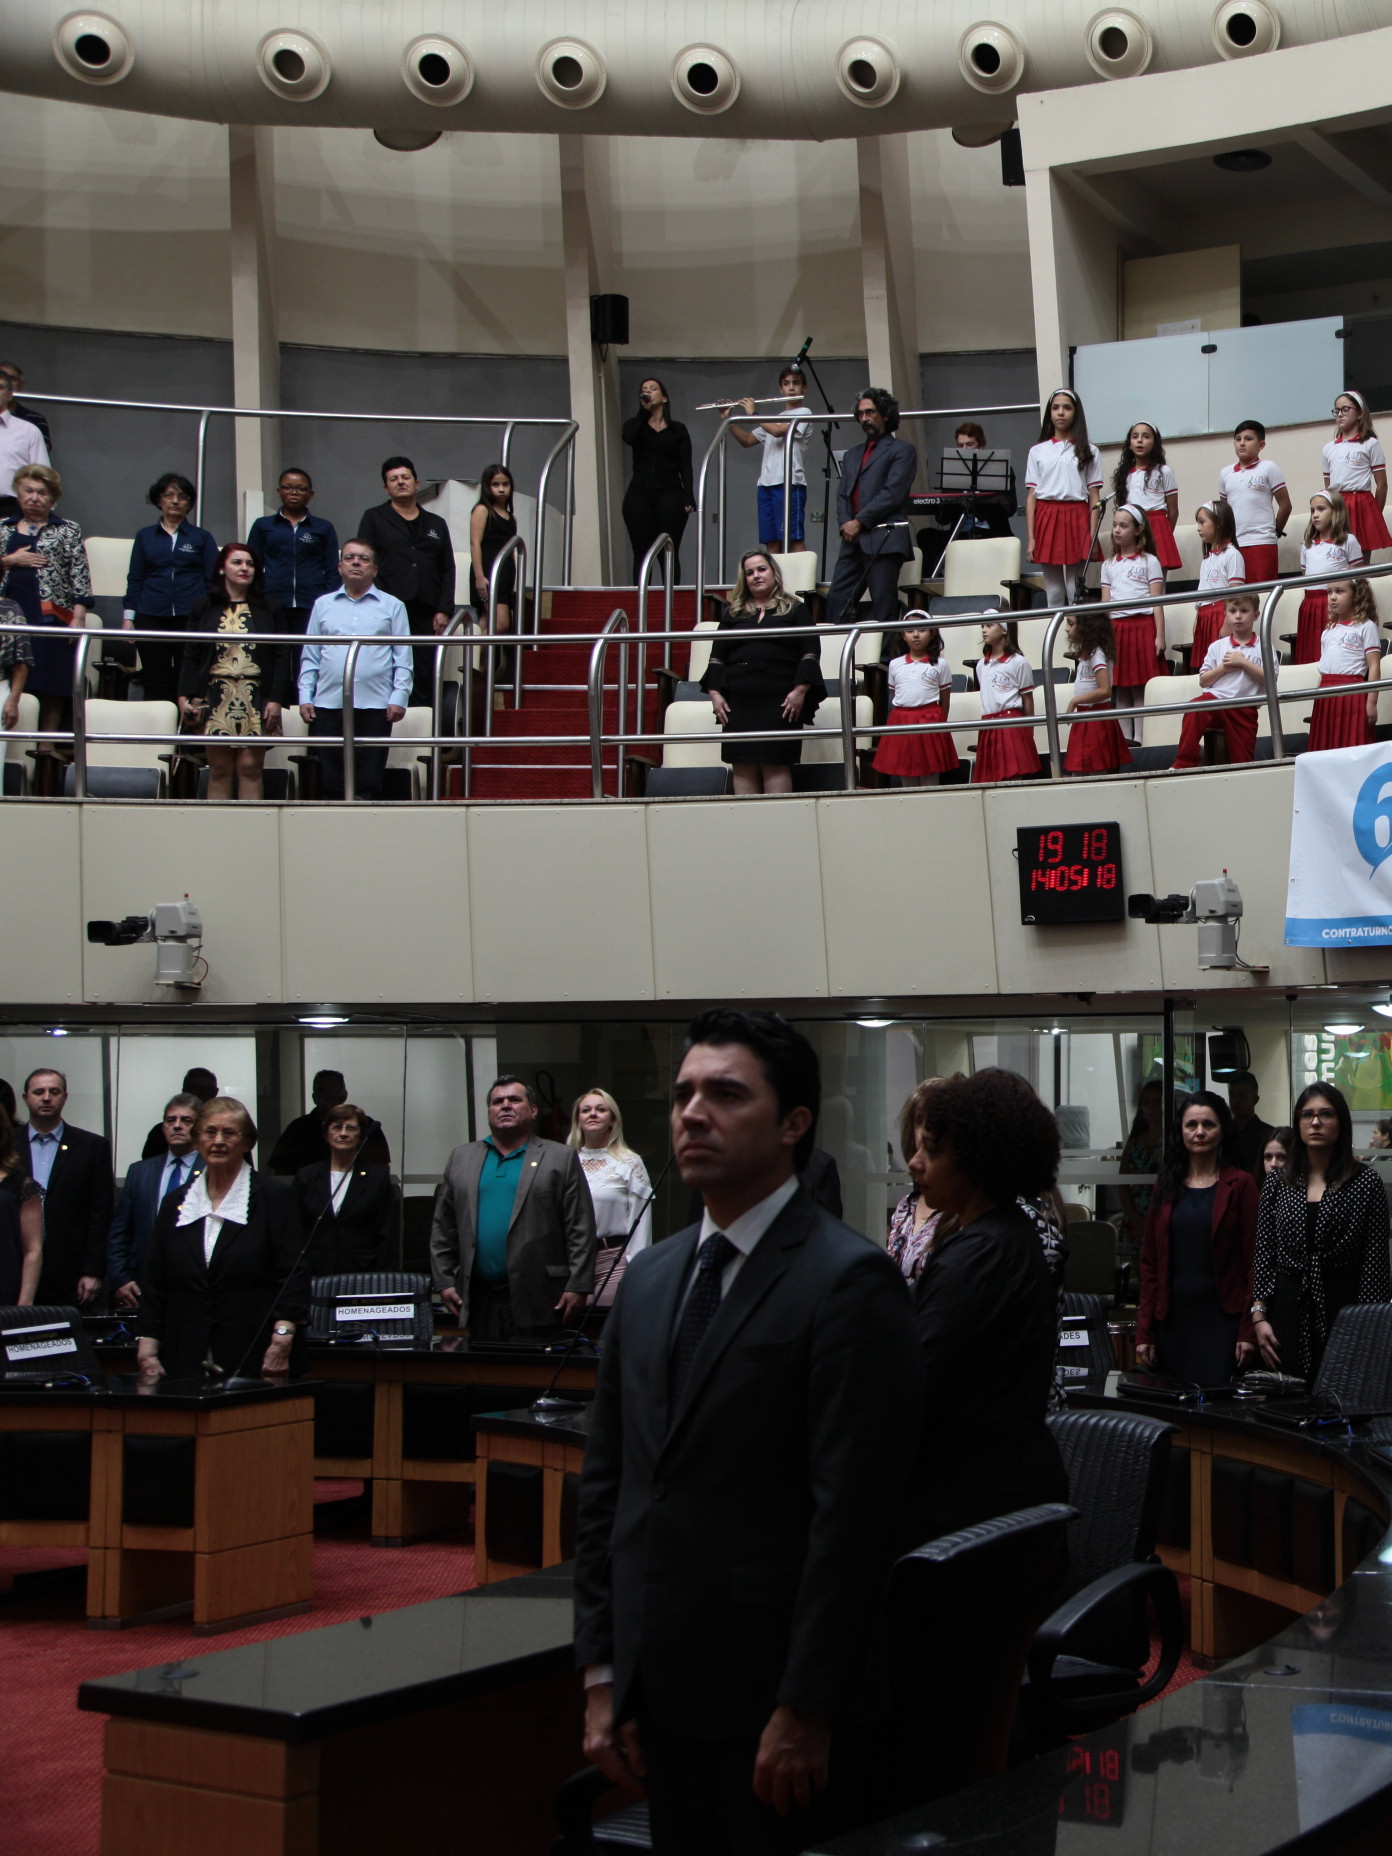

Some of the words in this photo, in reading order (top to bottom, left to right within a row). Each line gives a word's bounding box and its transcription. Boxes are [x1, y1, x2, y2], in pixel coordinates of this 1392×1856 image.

[1037, 830, 1065, 864] 19
[1082, 828, 1109, 862] 18
[337, 1305, 412, 1315] HOMENAGEADOS
[8, 1338, 73, 1354] HOMENAGEADOS
